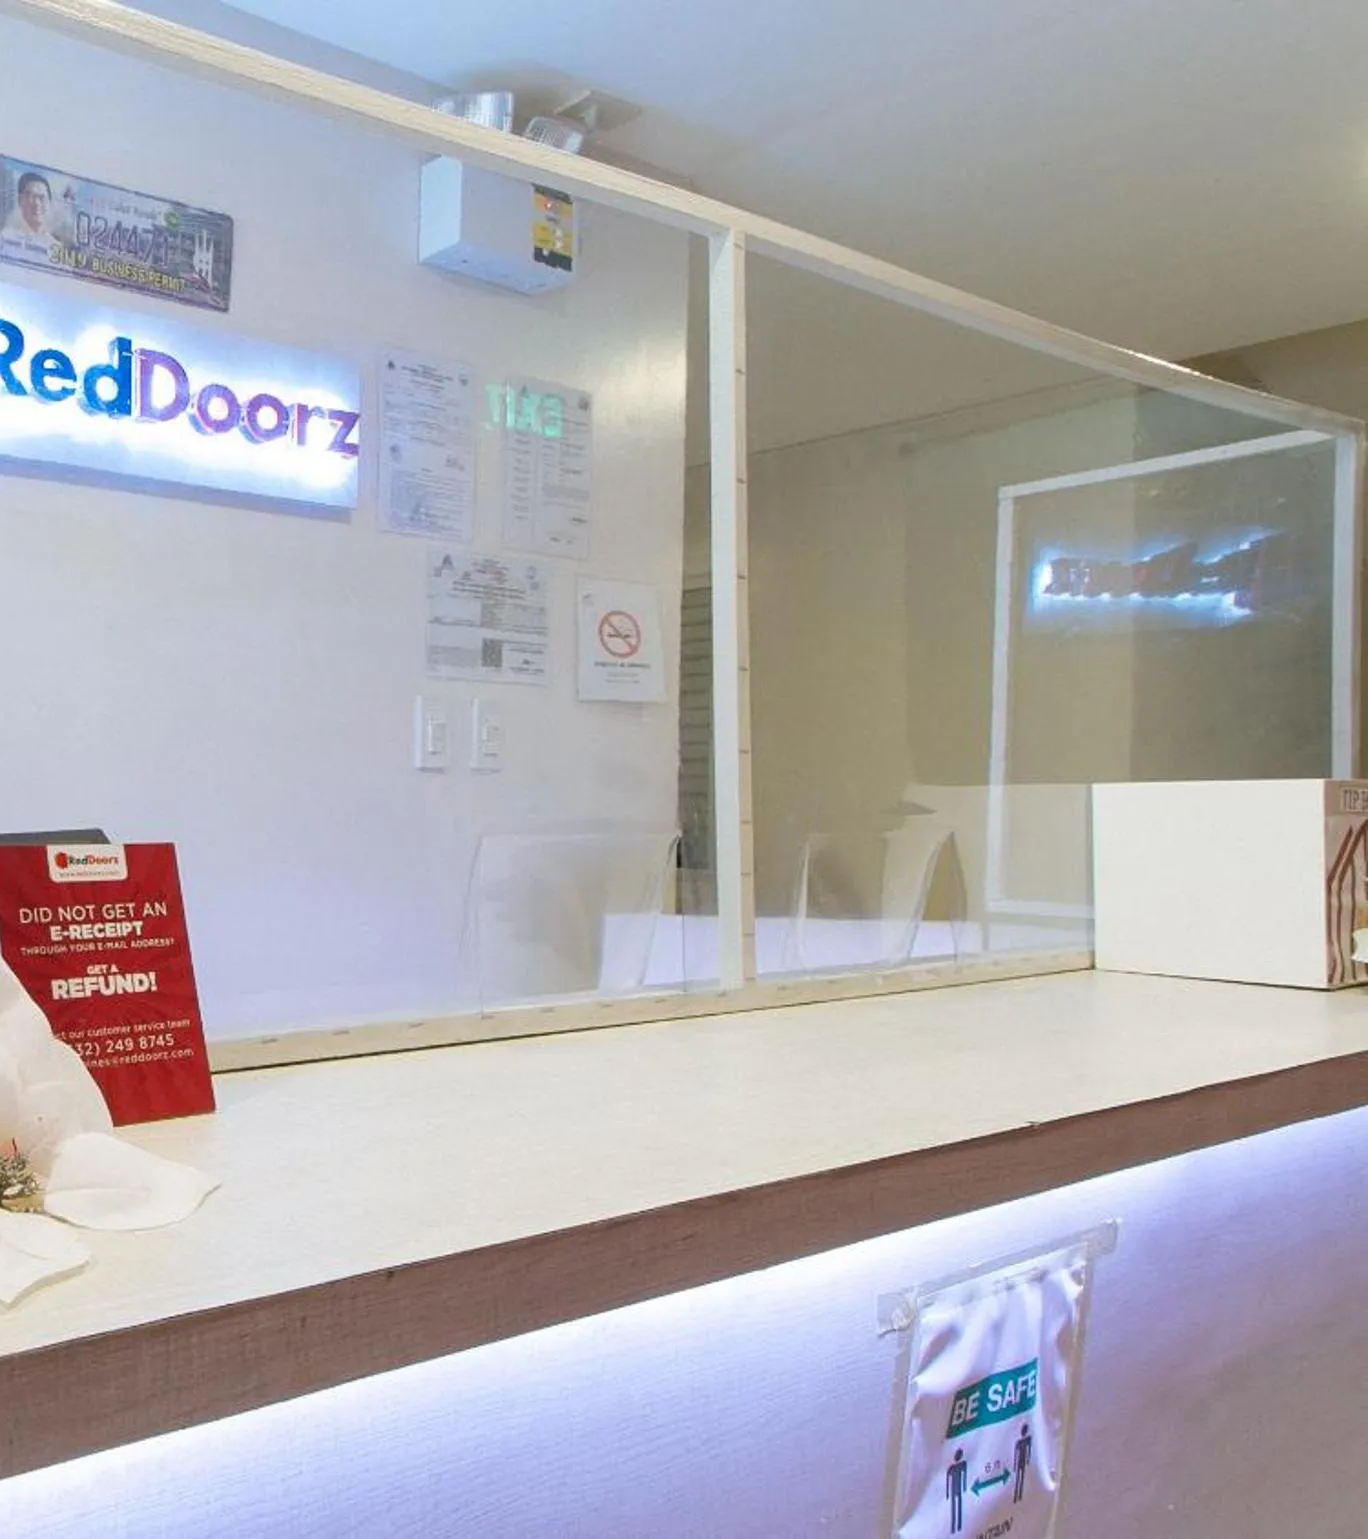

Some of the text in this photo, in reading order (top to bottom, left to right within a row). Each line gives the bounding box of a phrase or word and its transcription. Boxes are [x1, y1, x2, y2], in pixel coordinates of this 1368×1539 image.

[92, 258, 146, 285] BUSINESS
[19, 901, 168, 924] DID NOT GET AN
[50, 920, 144, 941] E-RECEIPT
[20, 945, 68, 956] THROUGH
[69, 943, 96, 953] YOUR
[97, 941, 129, 951] E-MAIL
[87, 963, 120, 975] GET A
[51, 971, 159, 1000] REFUND!
[68, 1029, 86, 1039] our
[87, 1024, 131, 1037] customer
[134, 1021, 166, 1033] service
[167, 1018, 191, 1029] team
[73, 1032, 175, 1057] 32) 249 8745
[952, 1369, 1037, 1426] BE SAFE
